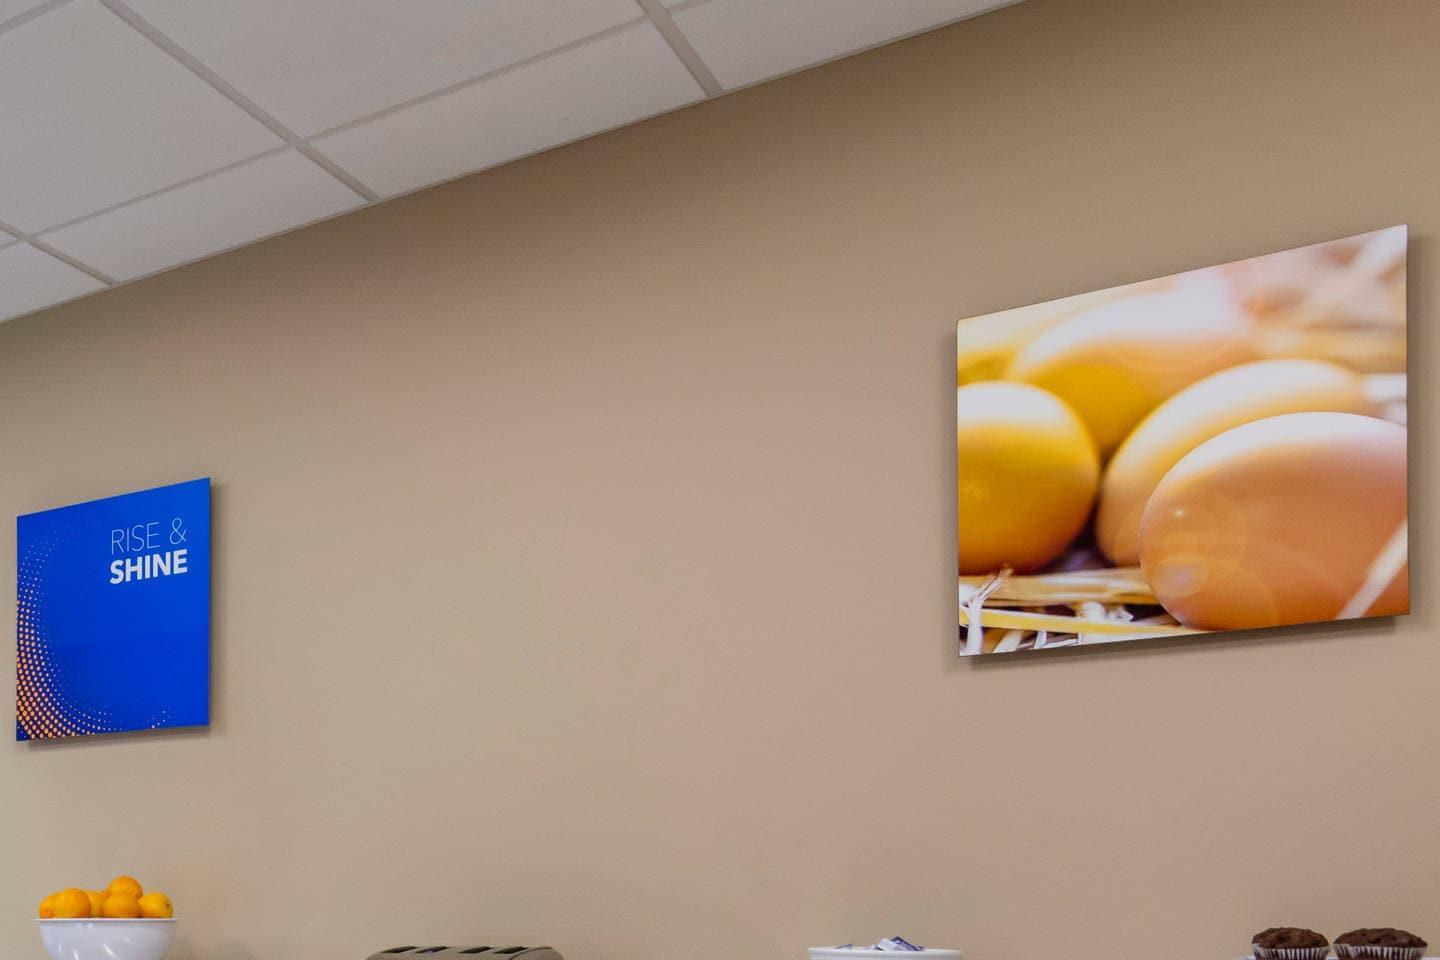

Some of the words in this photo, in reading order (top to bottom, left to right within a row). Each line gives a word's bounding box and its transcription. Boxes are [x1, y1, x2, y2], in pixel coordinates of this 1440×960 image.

[111, 521, 160, 555] RISE
[169, 517, 187, 545] &
[110, 549, 188, 584] SHINE
